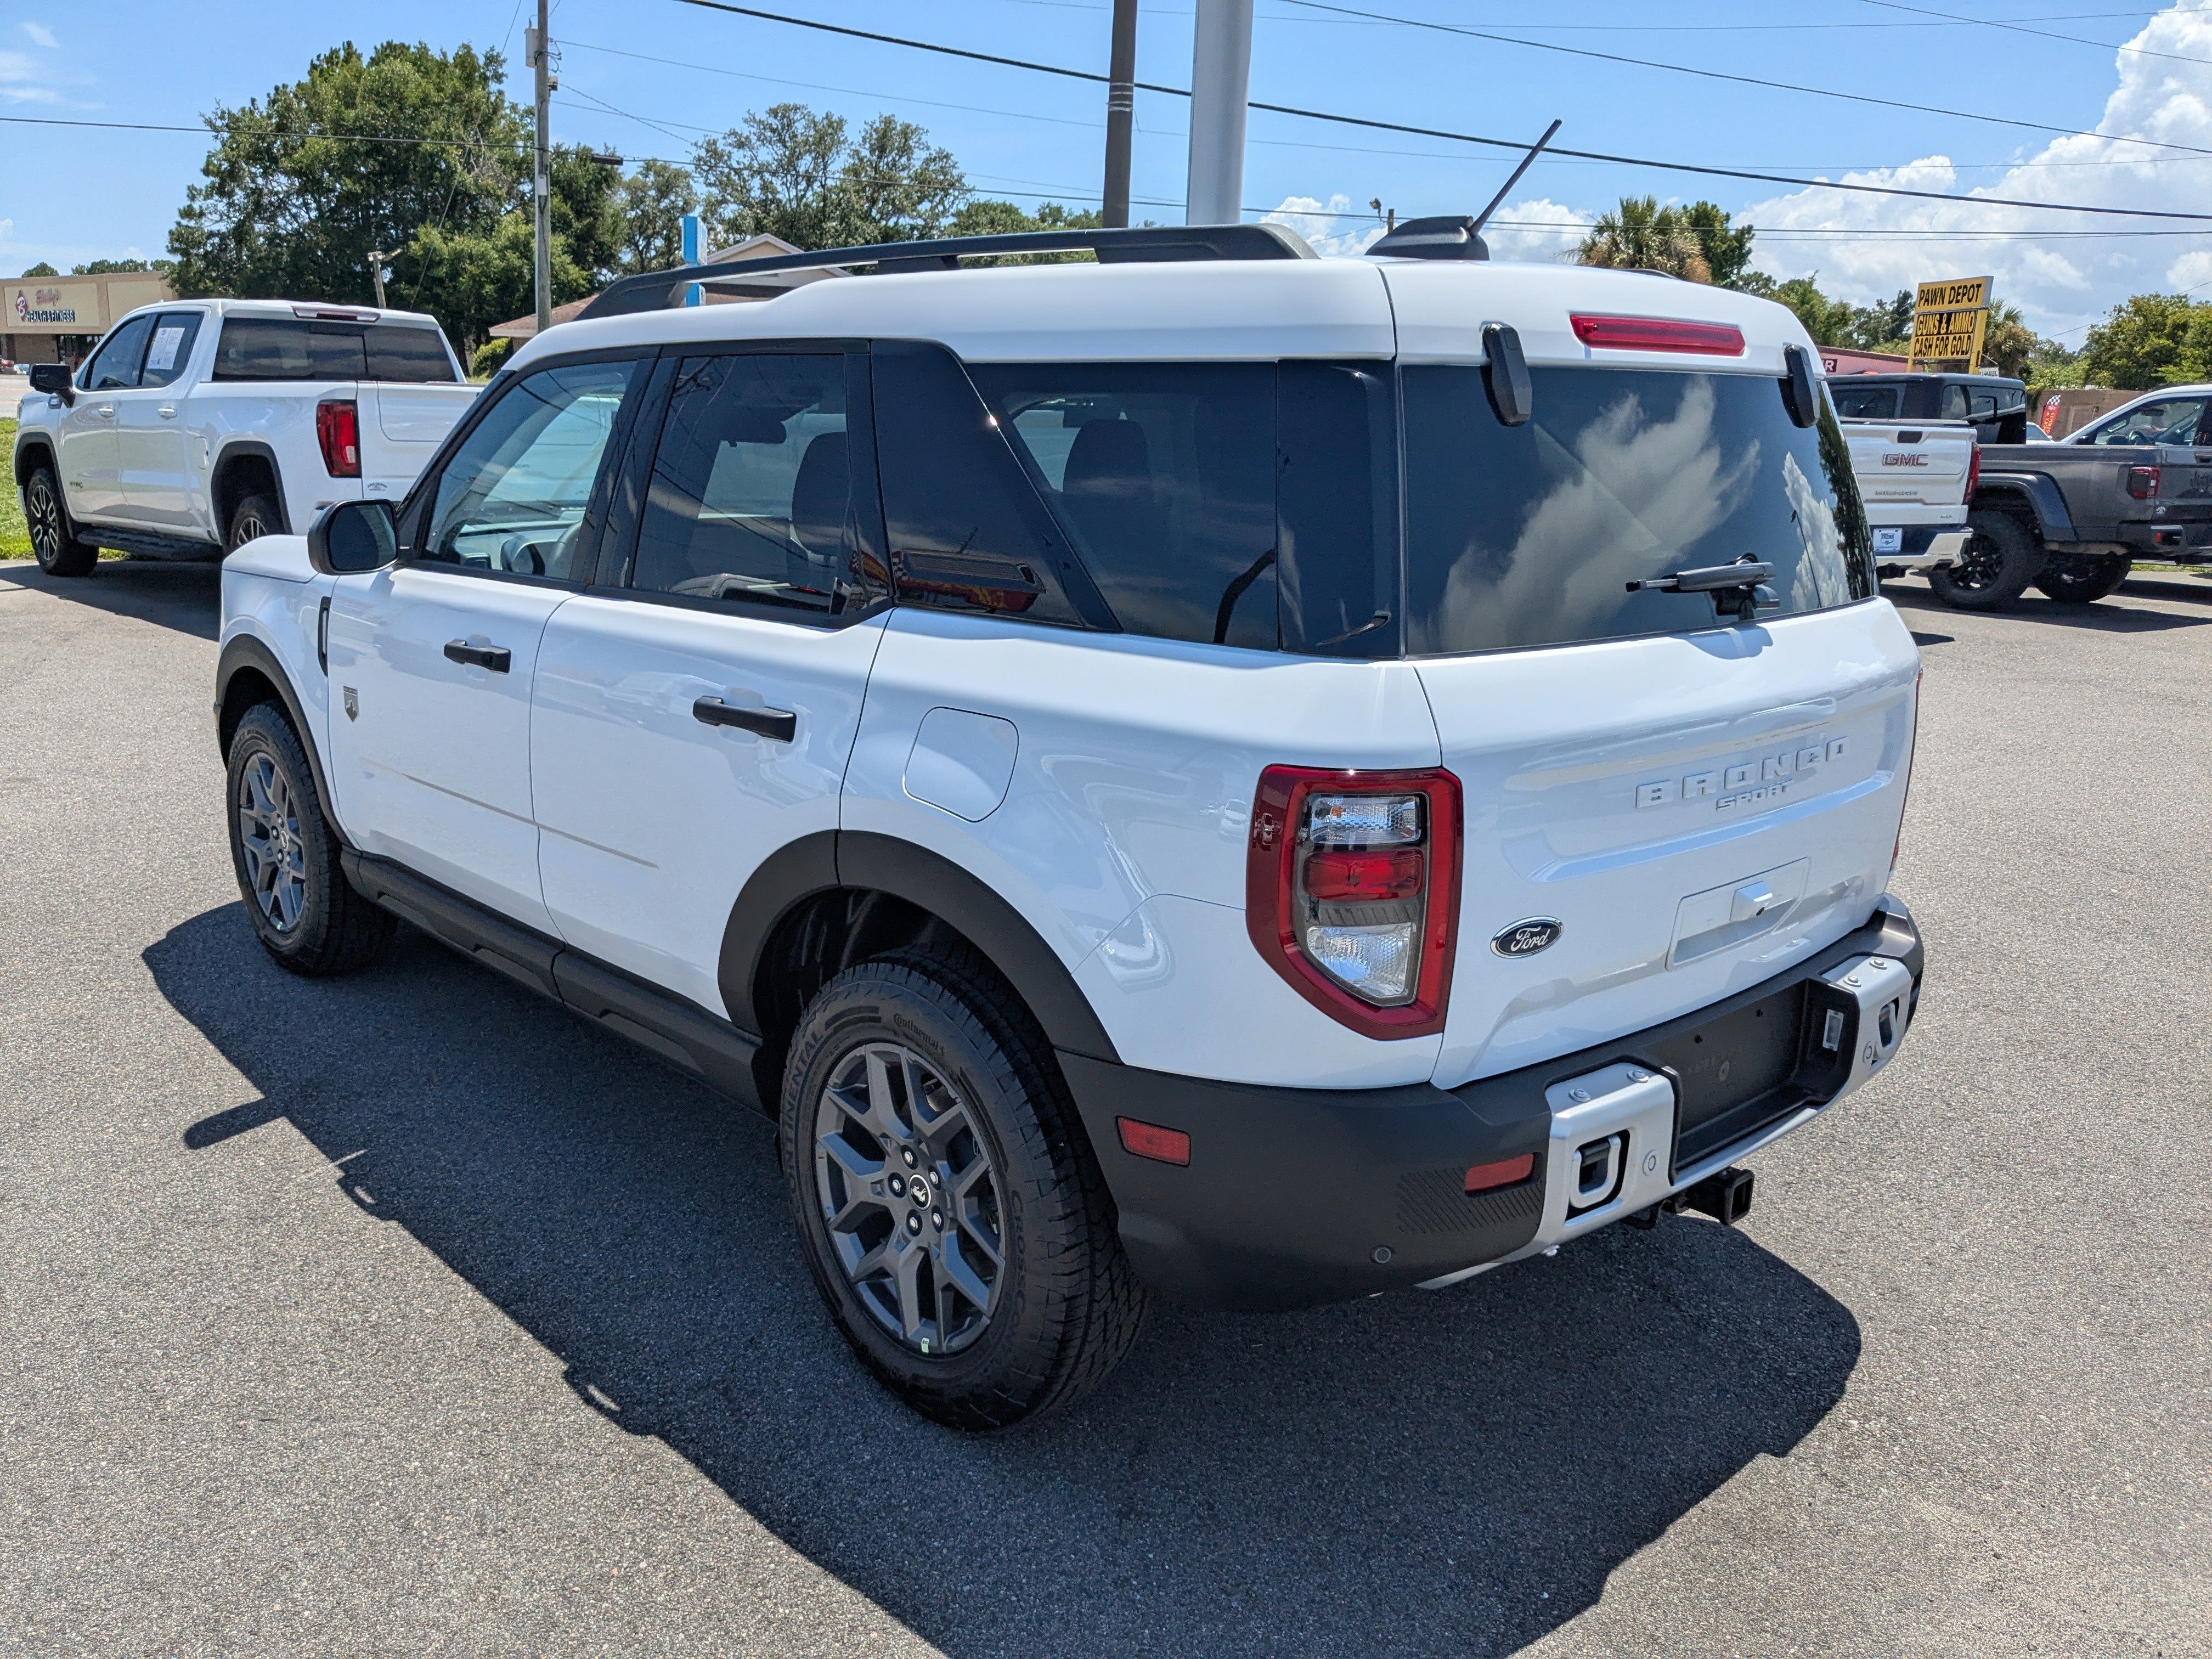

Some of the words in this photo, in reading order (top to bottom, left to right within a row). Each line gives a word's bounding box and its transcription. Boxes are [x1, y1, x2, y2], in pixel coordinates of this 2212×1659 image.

[1918, 287, 1946, 307] PAWN
[1948, 283, 1982, 304] DEPOT
[27, 310, 47, 322] HEALTH
[52, 310, 75, 322] FITNESS
[1917, 313, 1940, 335] GUNS
[1940, 313, 1947, 334] &
[1948, 311, 1976, 334] AMMO
[1914, 337, 1934, 358] CASH
[1934, 336, 1949, 357] FOR
[1950, 335, 1971, 357] GOLD
[1882, 453, 1929, 466] GMC
[1635, 736, 1848, 809] BRONCO
[1716, 780, 1795, 811] SPORT
[1510, 926, 1551, 951] Ford
[894, 1013, 940, 1050] Continental
[782, 1030, 823, 1215] CONTINENTAL
